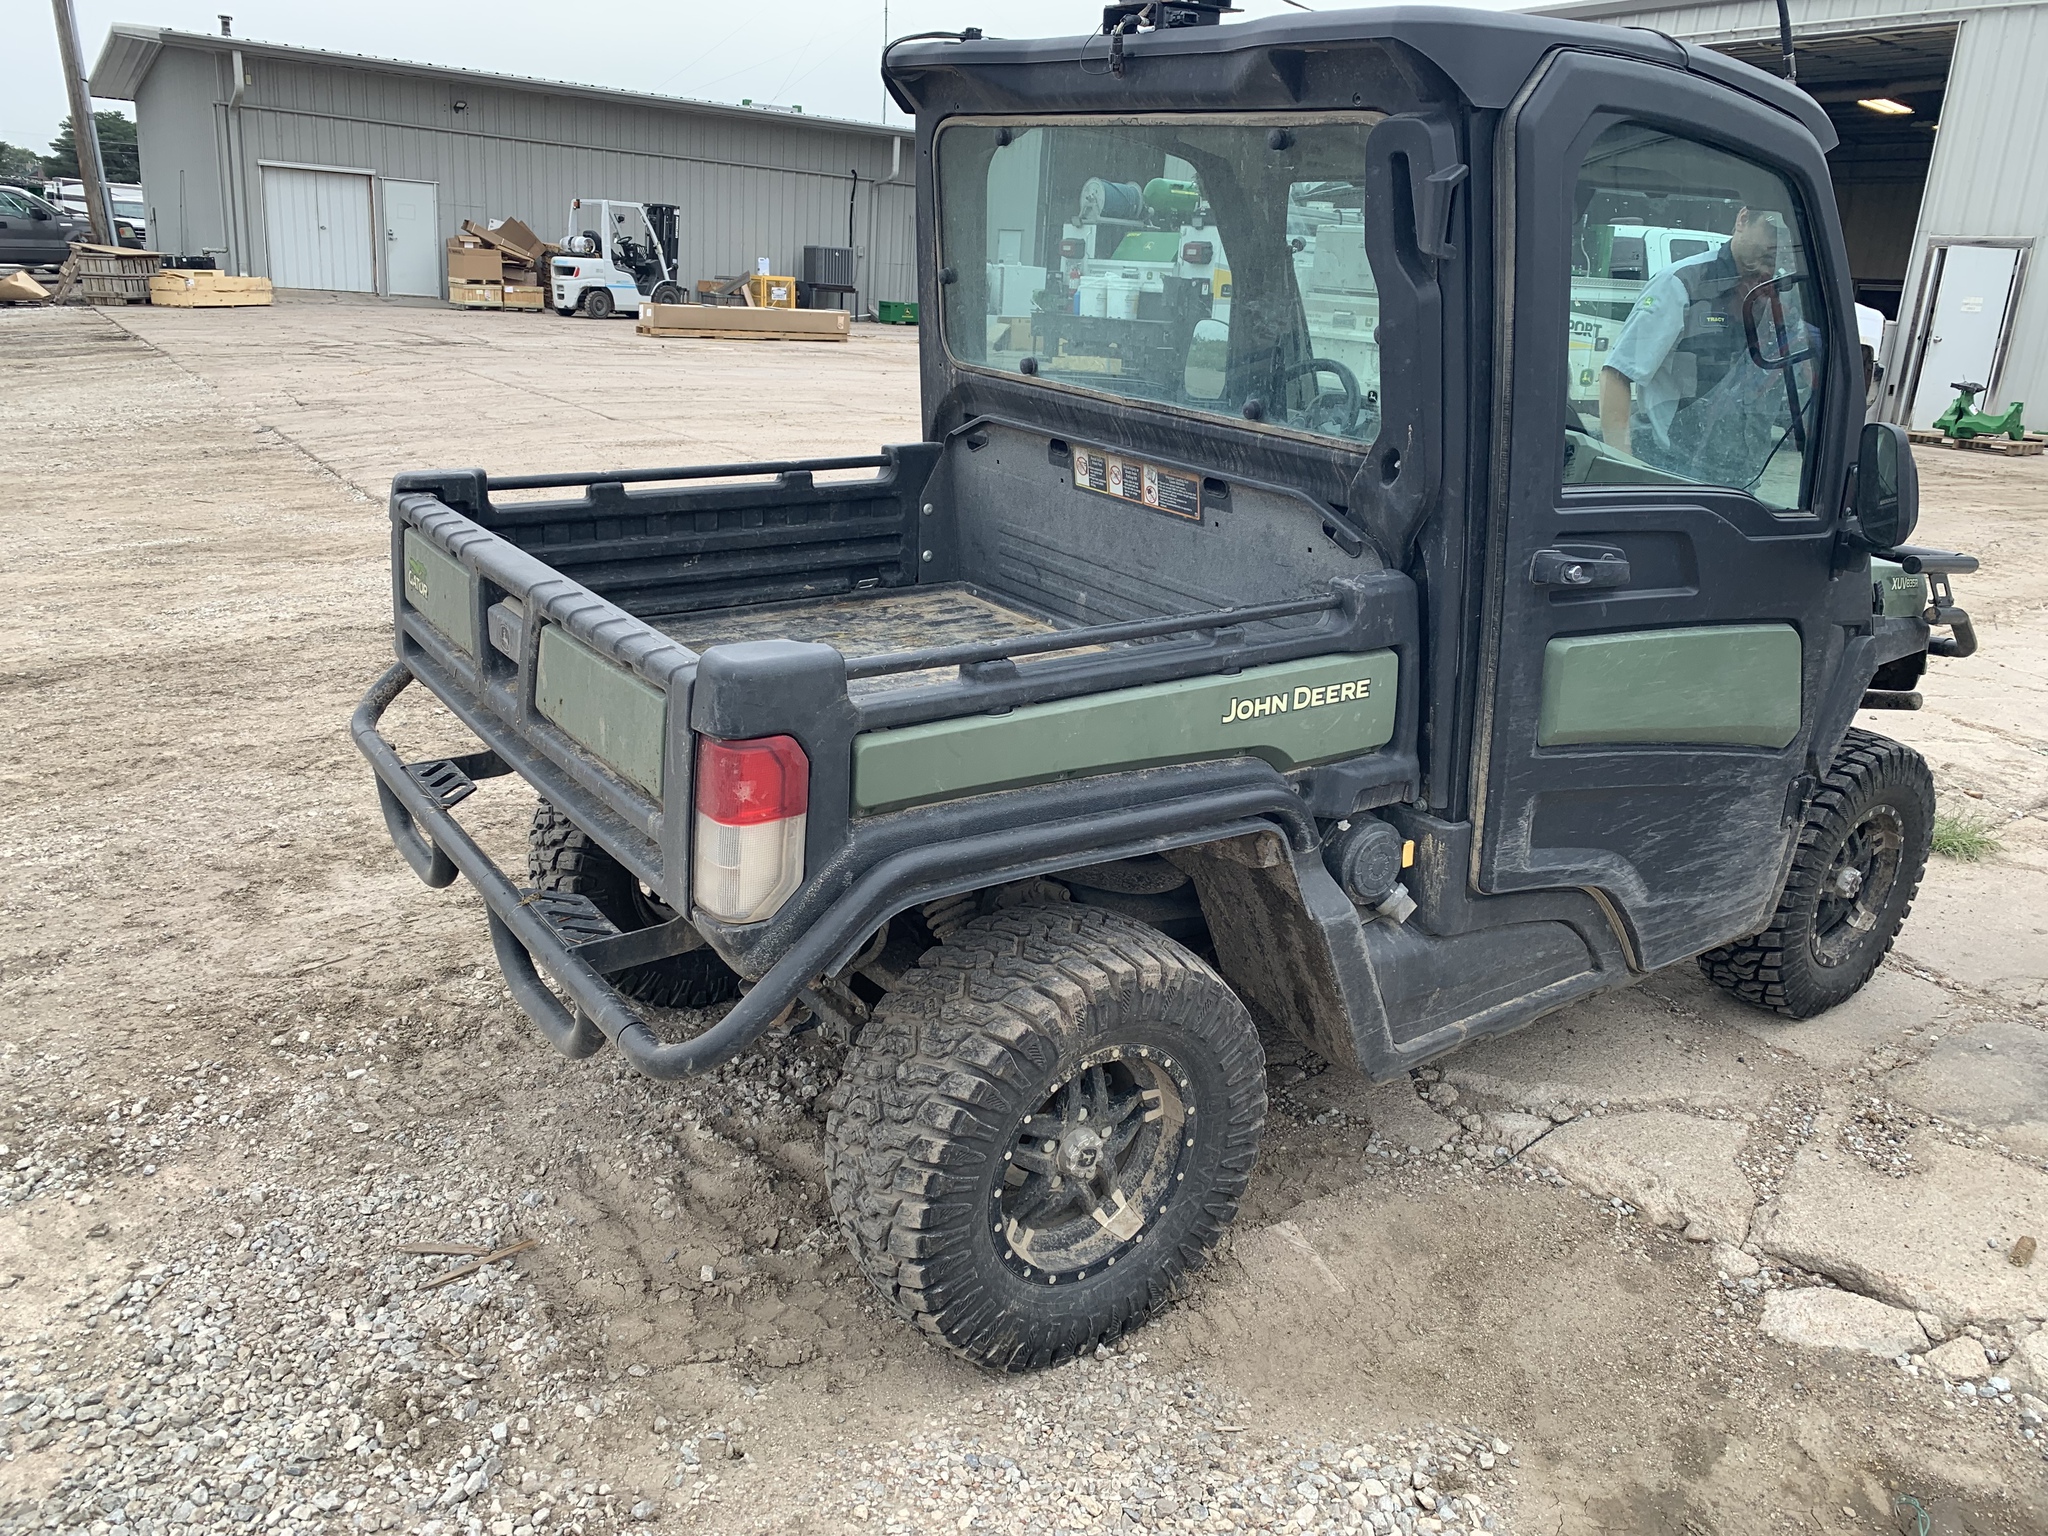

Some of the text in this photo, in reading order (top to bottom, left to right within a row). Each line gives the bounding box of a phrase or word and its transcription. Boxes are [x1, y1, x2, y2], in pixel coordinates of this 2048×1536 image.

[408, 570, 429, 600] GATOR
[1222, 678, 1371, 724] JOHN DEERE
